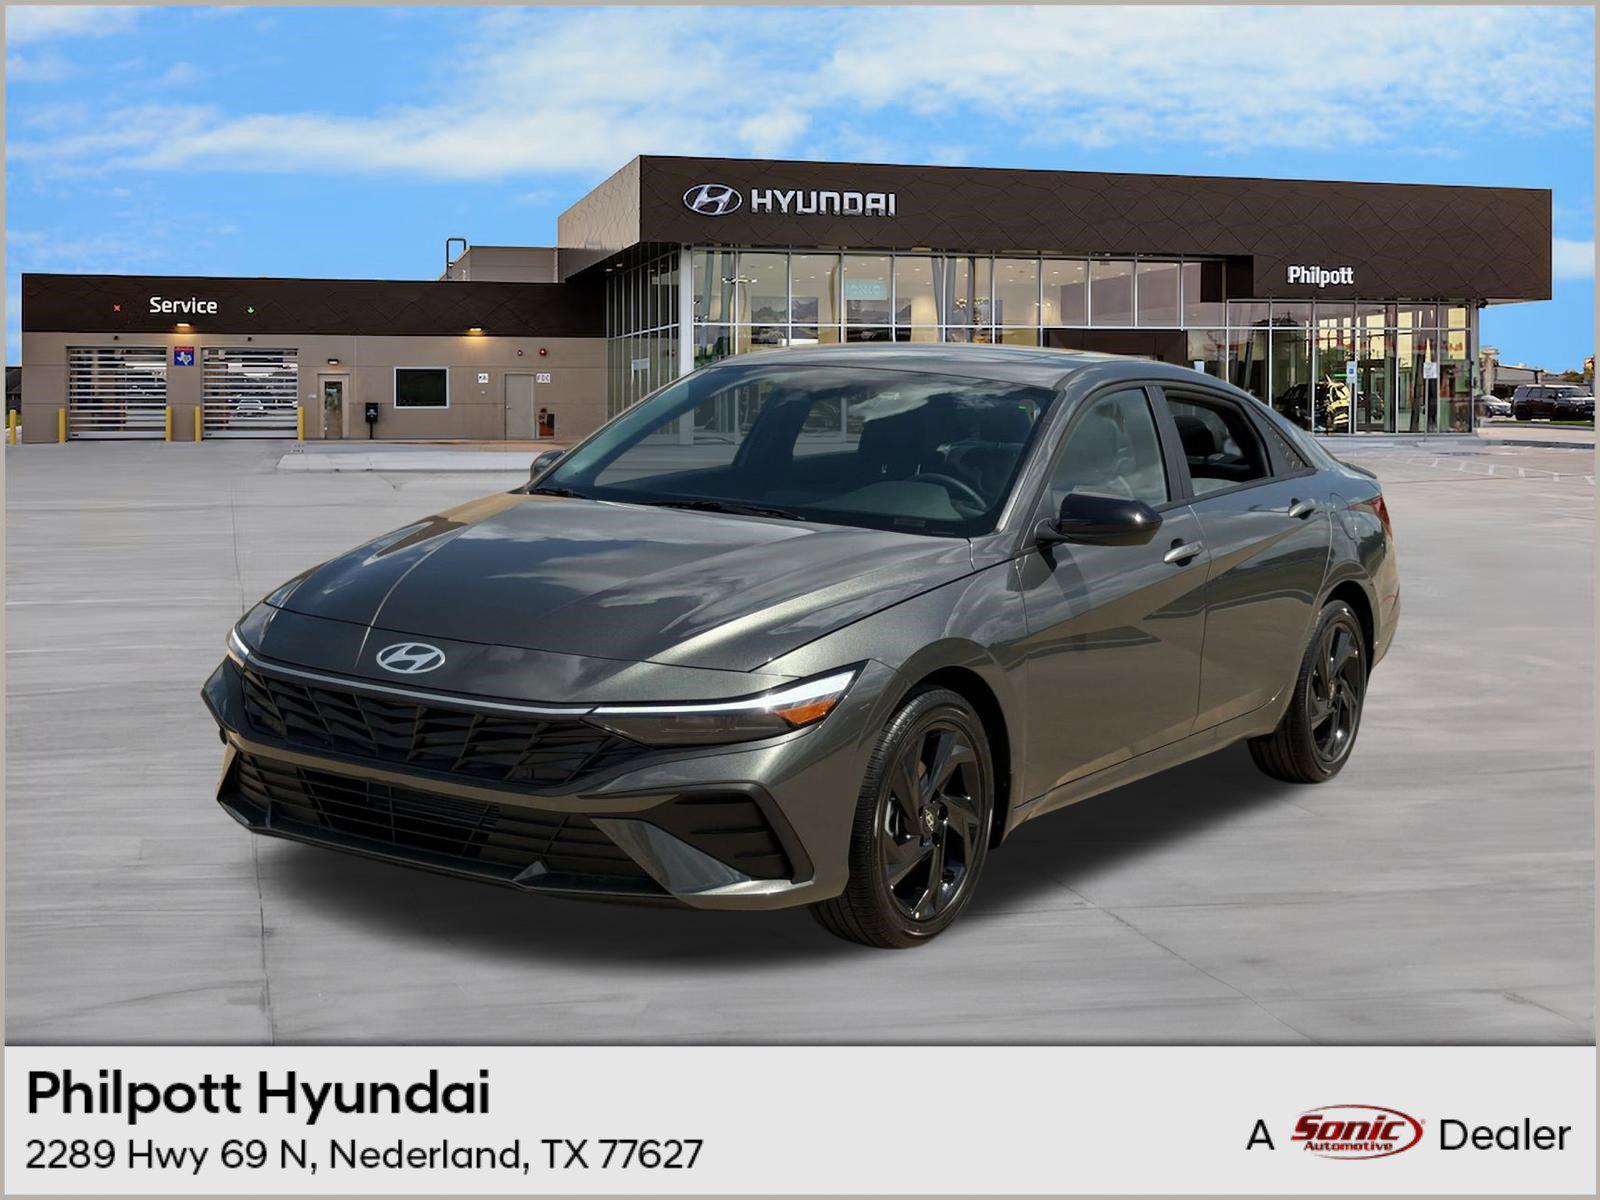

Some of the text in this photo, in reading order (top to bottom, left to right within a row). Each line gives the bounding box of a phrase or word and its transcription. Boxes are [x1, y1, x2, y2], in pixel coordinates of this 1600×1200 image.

[751, 188, 897, 217] HYUNDAI
[1287, 265, 1354, 289] Philpott
[149, 296, 218, 314] Service
